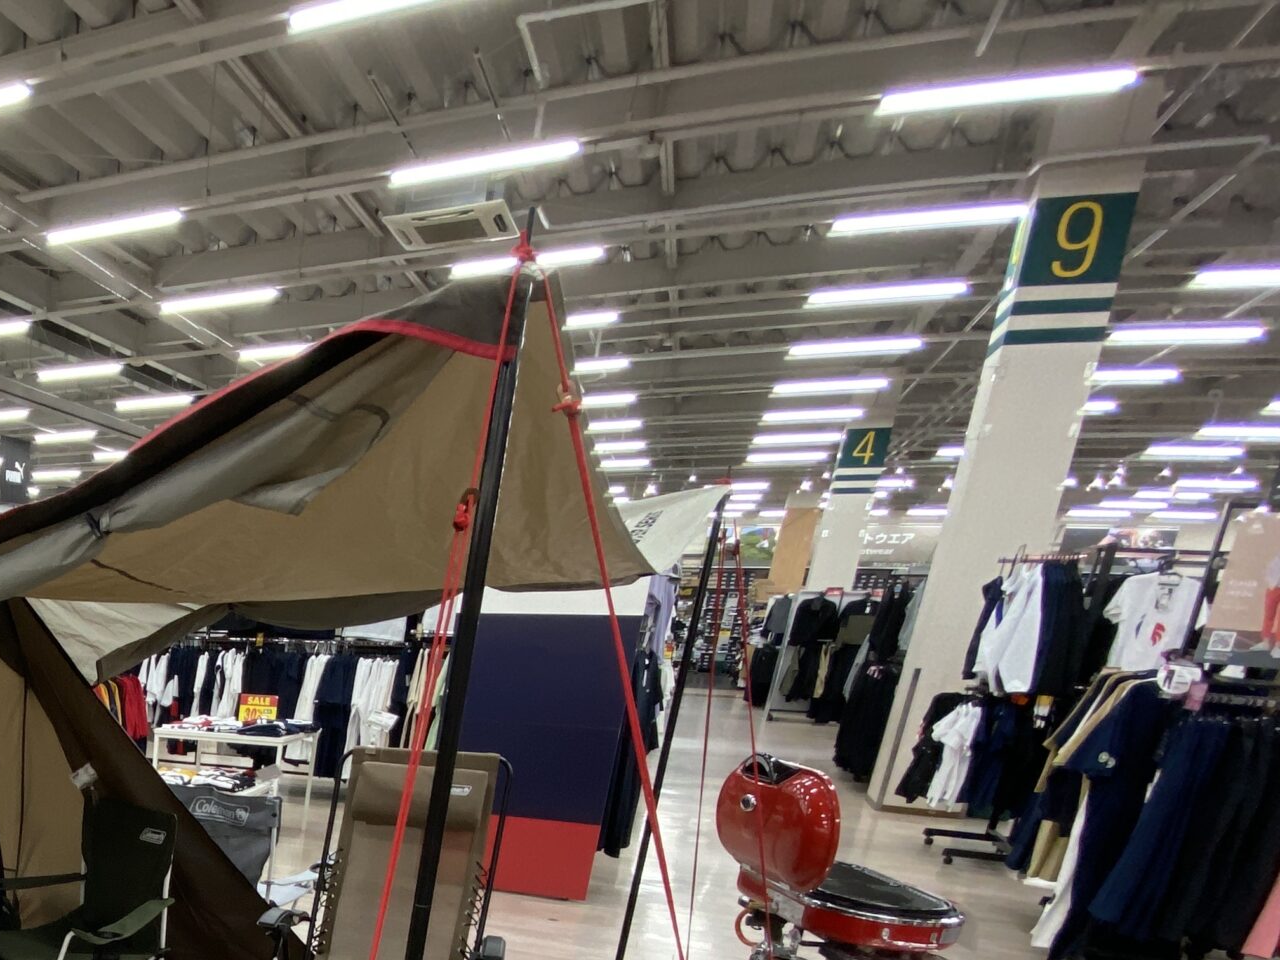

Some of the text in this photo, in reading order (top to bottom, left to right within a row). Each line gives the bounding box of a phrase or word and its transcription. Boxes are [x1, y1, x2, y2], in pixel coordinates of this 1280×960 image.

[1051, 201, 1103, 278] 9
[852, 431, 875, 464] 4
[248, 696, 271, 706] SALE
